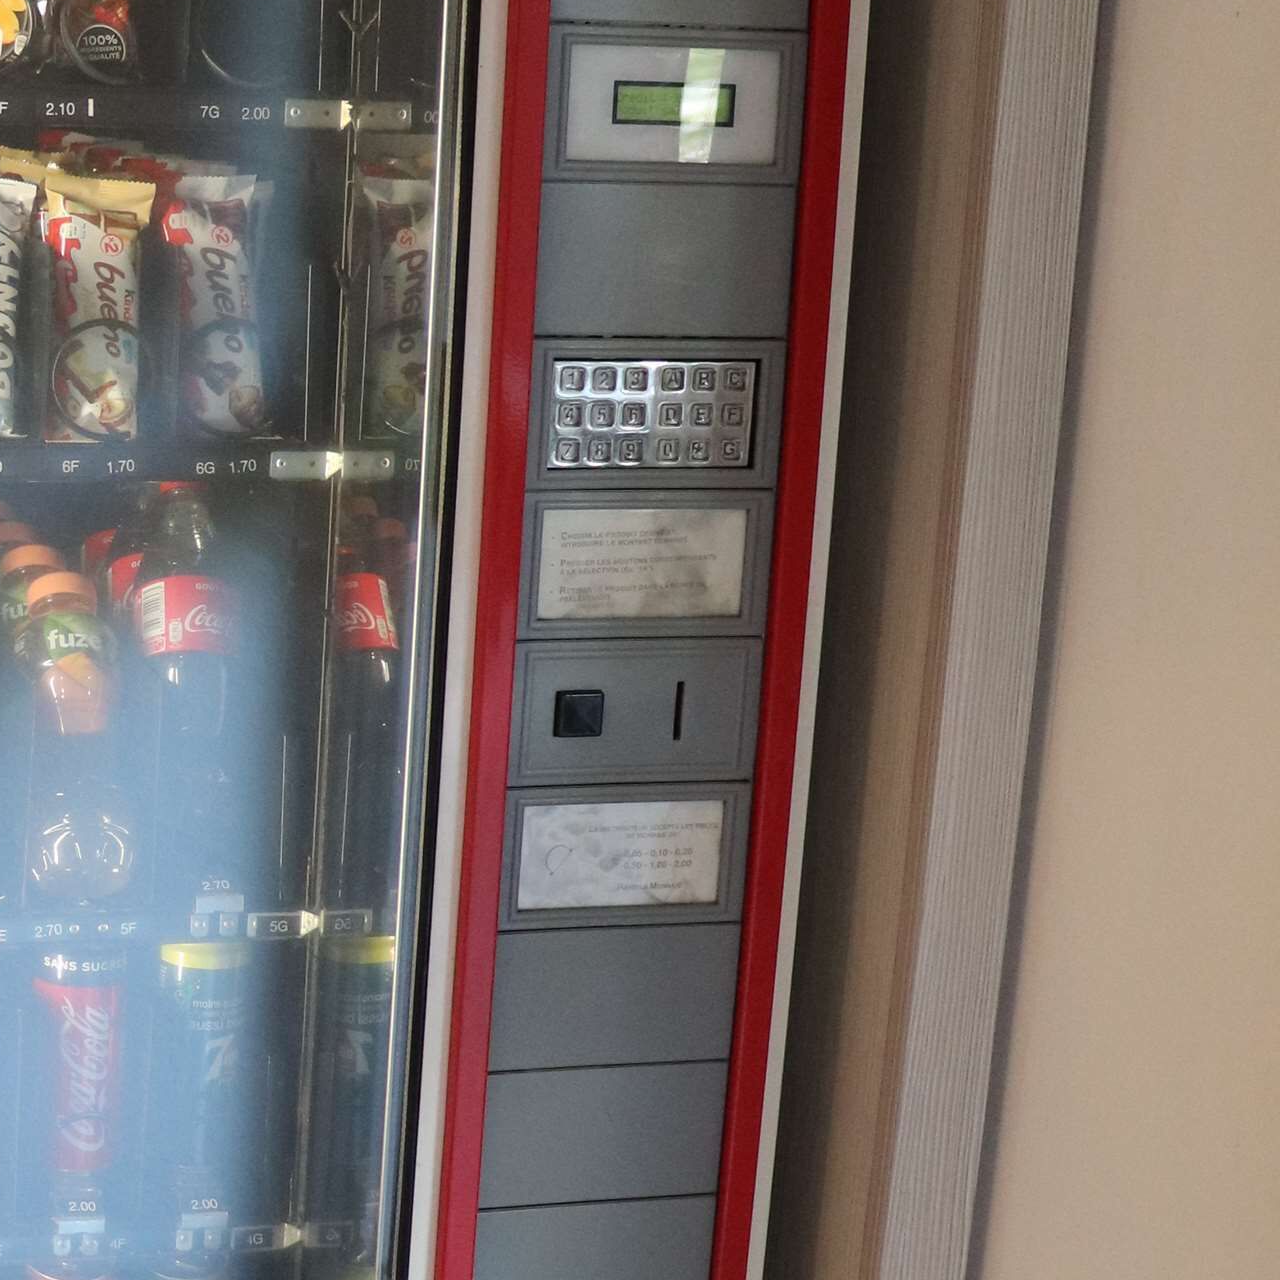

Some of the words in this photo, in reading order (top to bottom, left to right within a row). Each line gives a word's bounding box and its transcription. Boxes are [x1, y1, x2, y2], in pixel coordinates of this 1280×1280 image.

[81, 34, 118, 46] 100%
[45, 102, 76, 116] 2.10
[200, 105, 220, 119] 7G
[241, 106, 271, 121] 2.00
[201, 247, 244, 354] bueno
[94, 261, 124, 359] bueno
[62, 459, 80, 473] 6F
[107, 459, 135, 474] 1.70
[195, 461, 215, 475] 6G
[229, 458, 257, 473] 1.70
[47, 628, 102, 651] fuze
[201, 879, 230, 891] 2.70
[34, 923, 63, 938] 2.70
[120, 922, 137, 935] 5F
[269, 920, 289, 933] 5G
[68, 1201, 96, 1212] 2.00
[191, 1198, 218, 1210] 2.00
